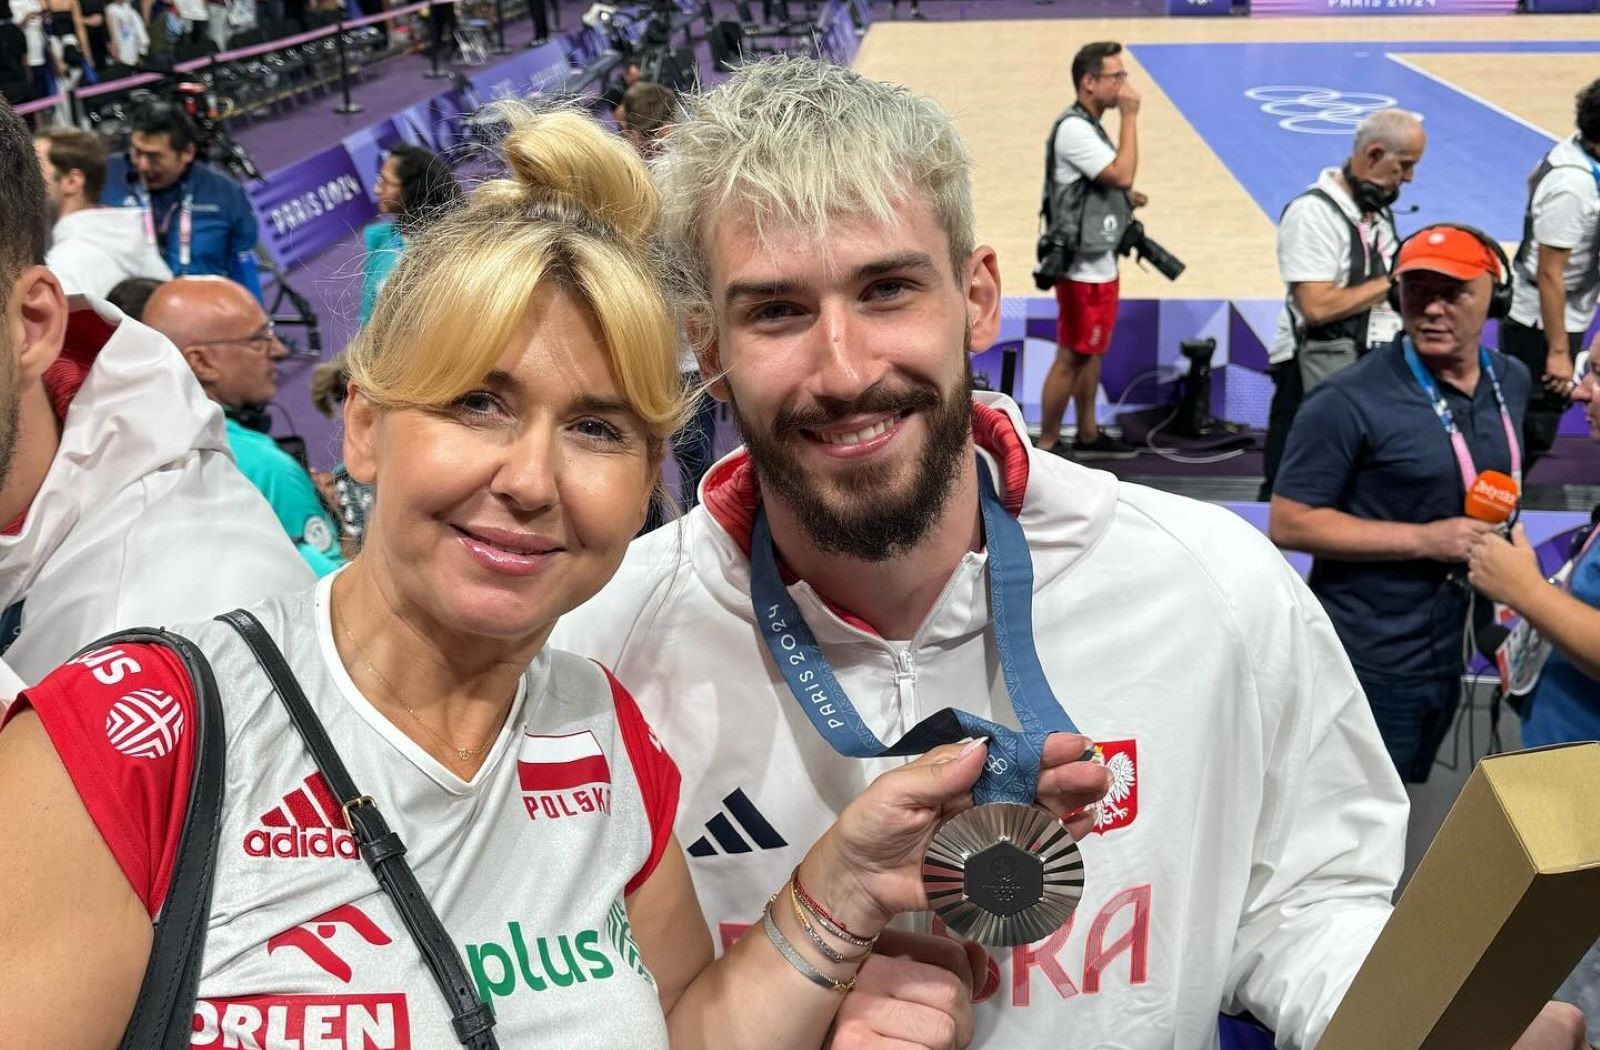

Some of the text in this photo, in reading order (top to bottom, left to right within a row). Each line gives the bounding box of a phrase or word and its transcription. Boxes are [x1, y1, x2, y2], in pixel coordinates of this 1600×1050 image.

[318, 173, 361, 211] 2024
[768, 604, 806, 666] 2024
[65, 646, 142, 685] us
[243, 825, 361, 860] adida
[465, 921, 614, 1017] plus
[189, 1000, 397, 1050] ORLEN
